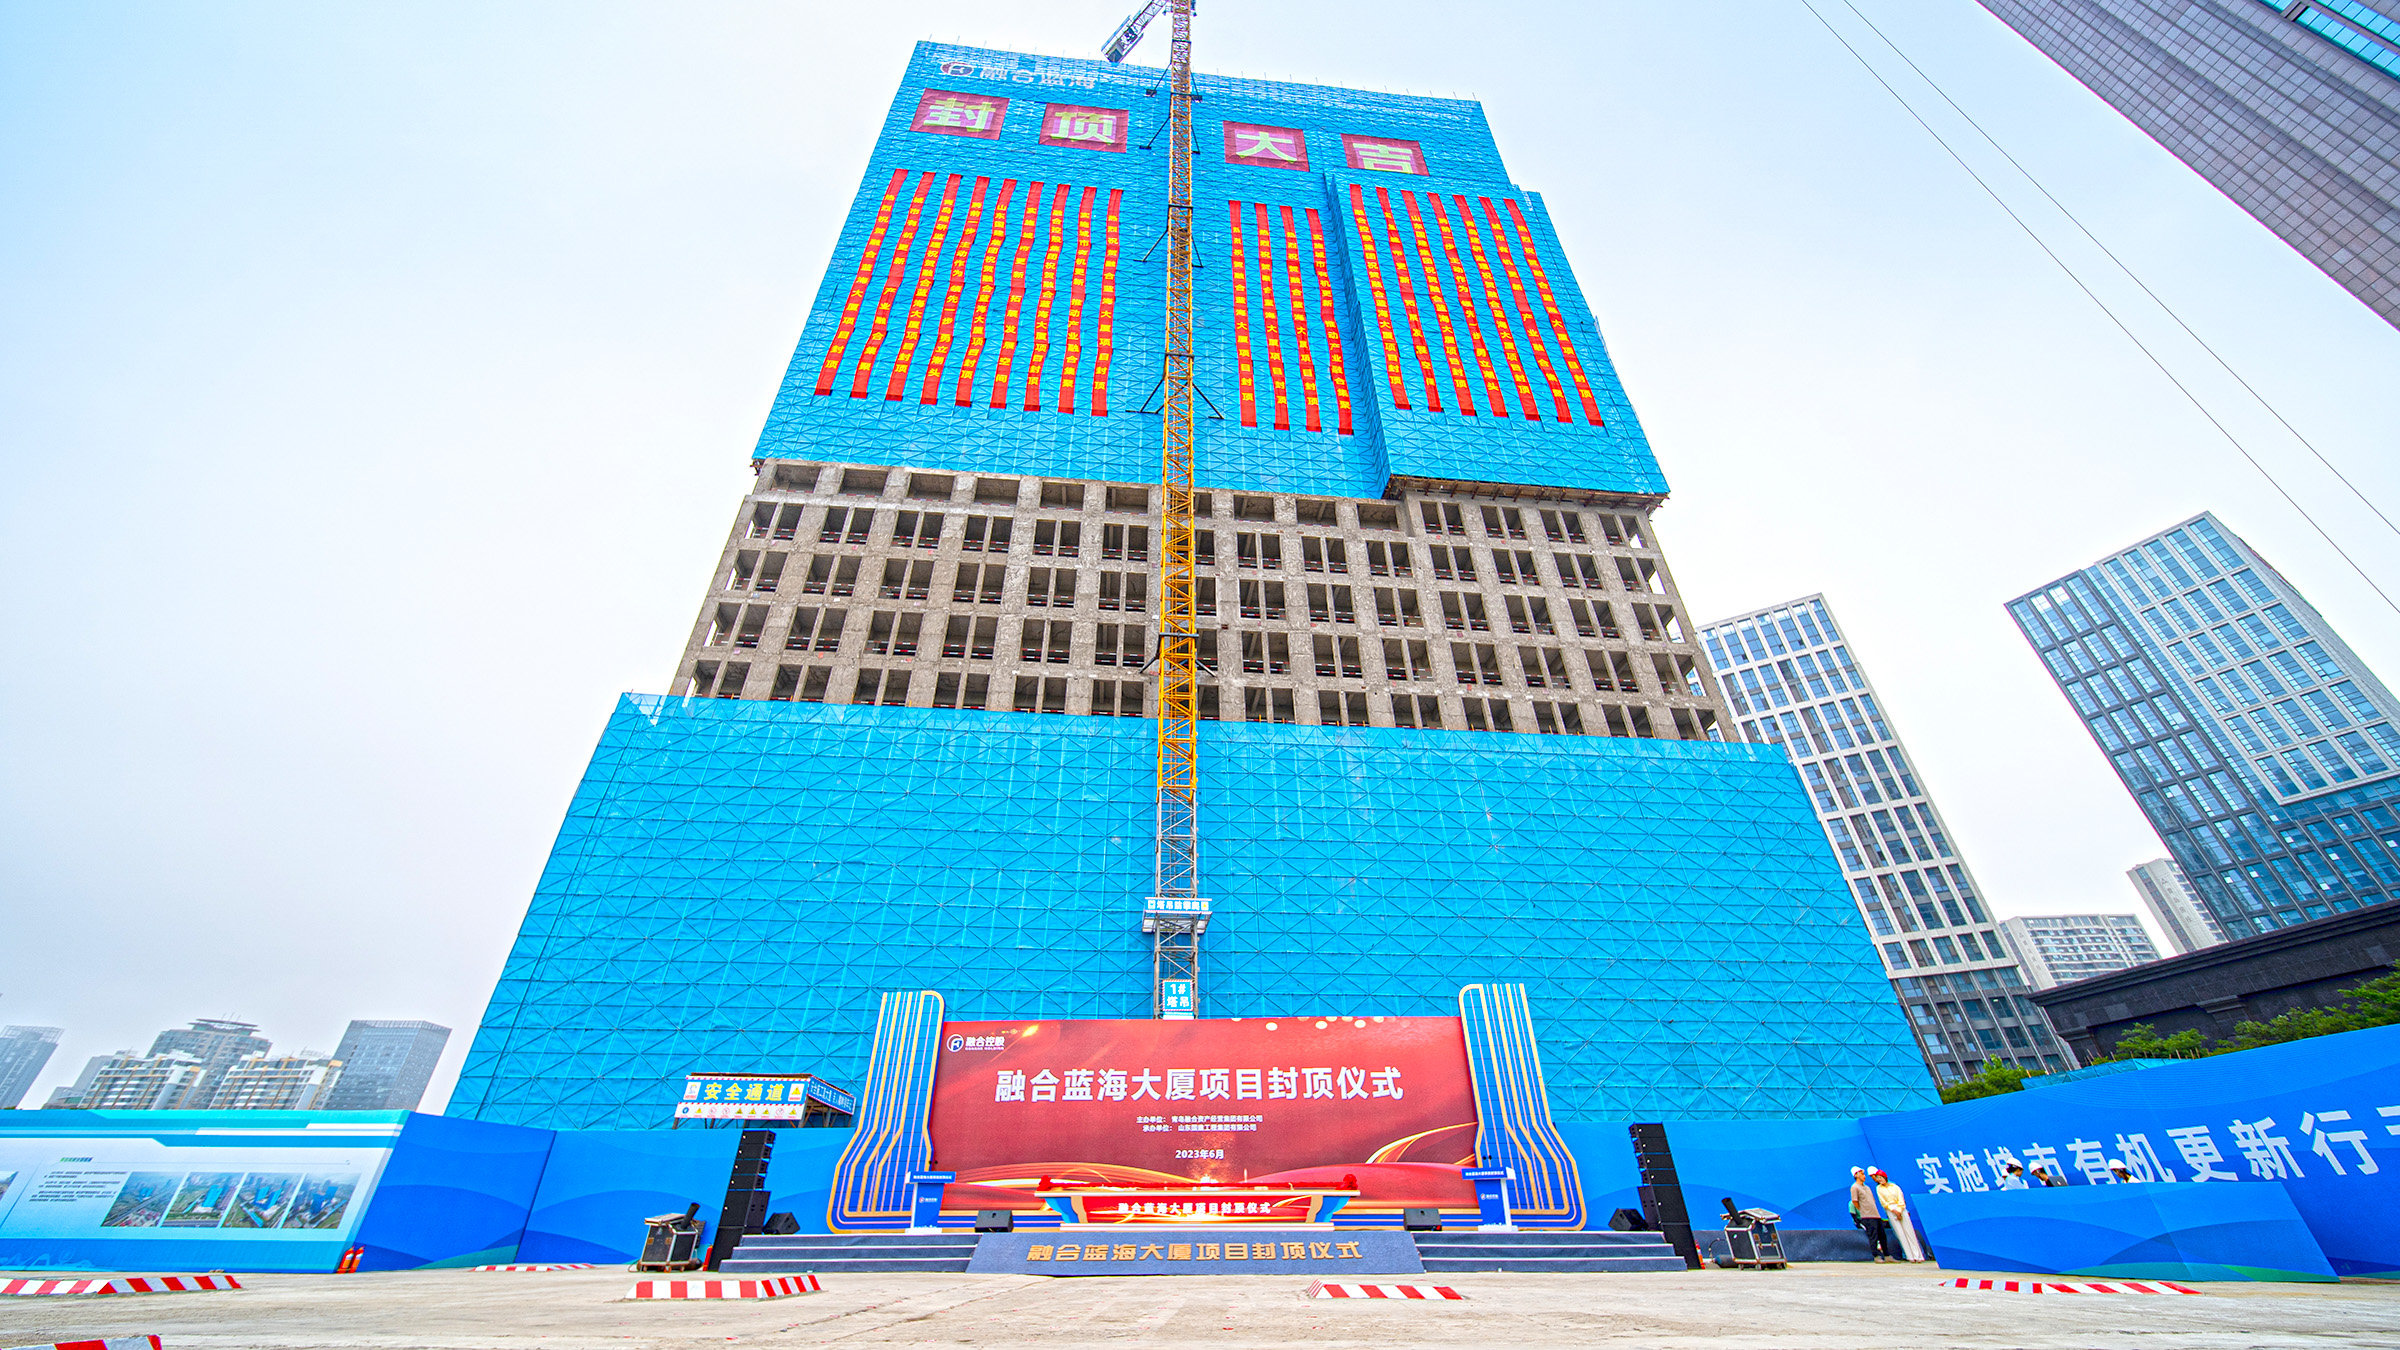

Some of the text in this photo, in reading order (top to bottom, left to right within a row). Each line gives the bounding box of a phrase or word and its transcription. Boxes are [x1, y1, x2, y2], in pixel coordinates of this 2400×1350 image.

[929, 97, 1414, 175] 封 顶 大 吉
[1170, 984, 1186, 995] 1#
[1167, 996, 1190, 1007] 塔吊
[965, 1036, 1005, 1047] 融合控股
[703, 1082, 785, 1101] 安全通道
[994, 1066, 1404, 1103] 融合蓝海大厦项目封顶仪式
[1175, 1149, 1225, 1160] 2023年6月
[1118, 1201, 1271, 1216] 融合蓝海大厦项目封顶仪式
[1026, 1241, 1363, 1262] 融合蓝海大厦项目封顶仪式
